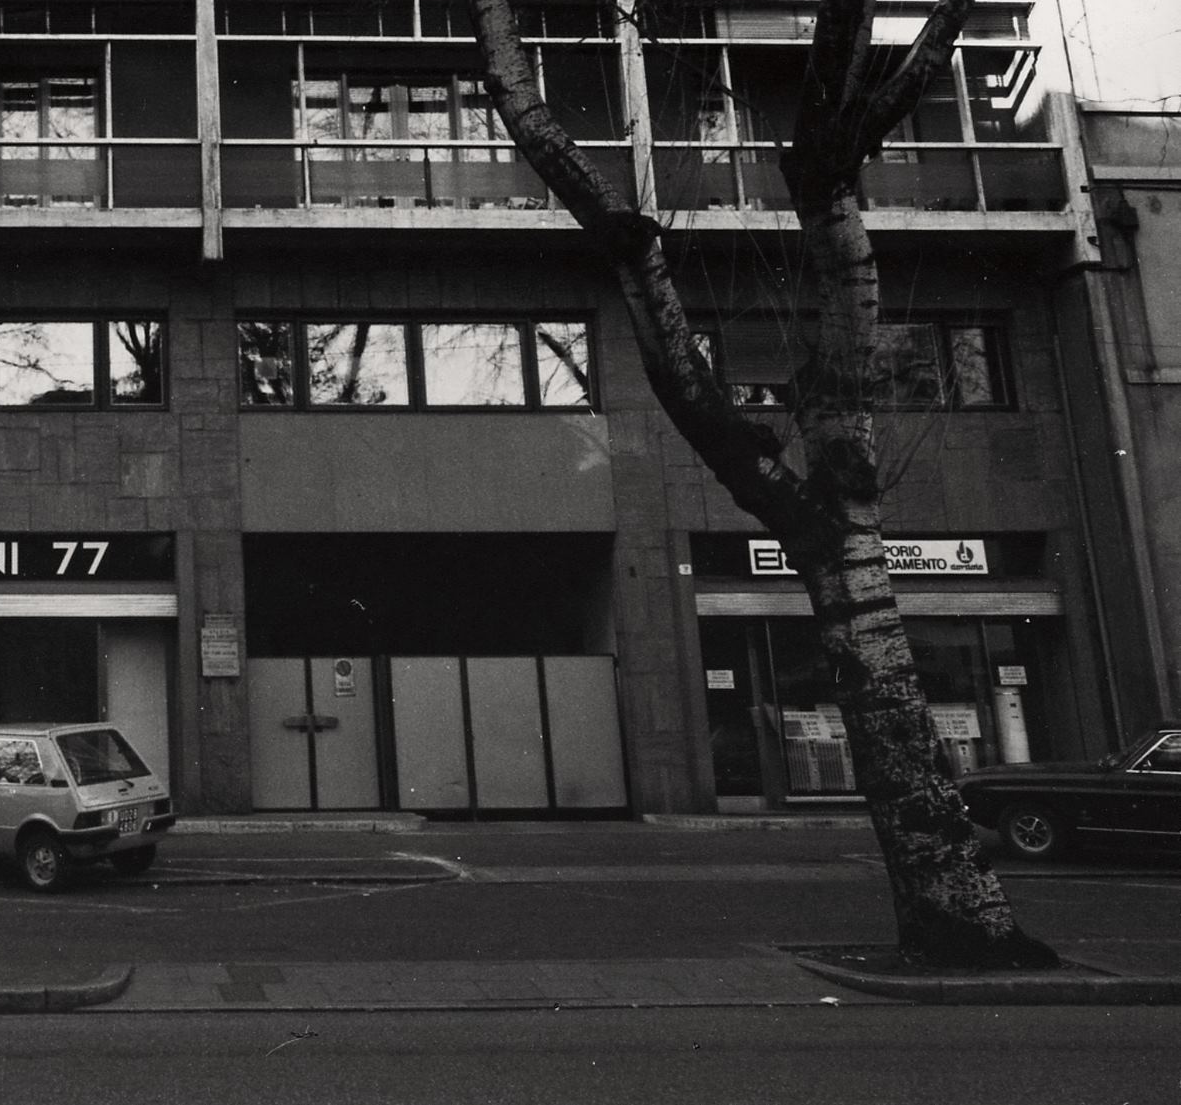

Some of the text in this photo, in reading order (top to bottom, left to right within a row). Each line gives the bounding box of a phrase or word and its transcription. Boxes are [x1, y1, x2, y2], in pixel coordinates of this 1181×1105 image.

[882, 545, 922, 557] PORIO
[52, 541, 110, 575] 77
[886, 558, 947, 570] DAMENTO
